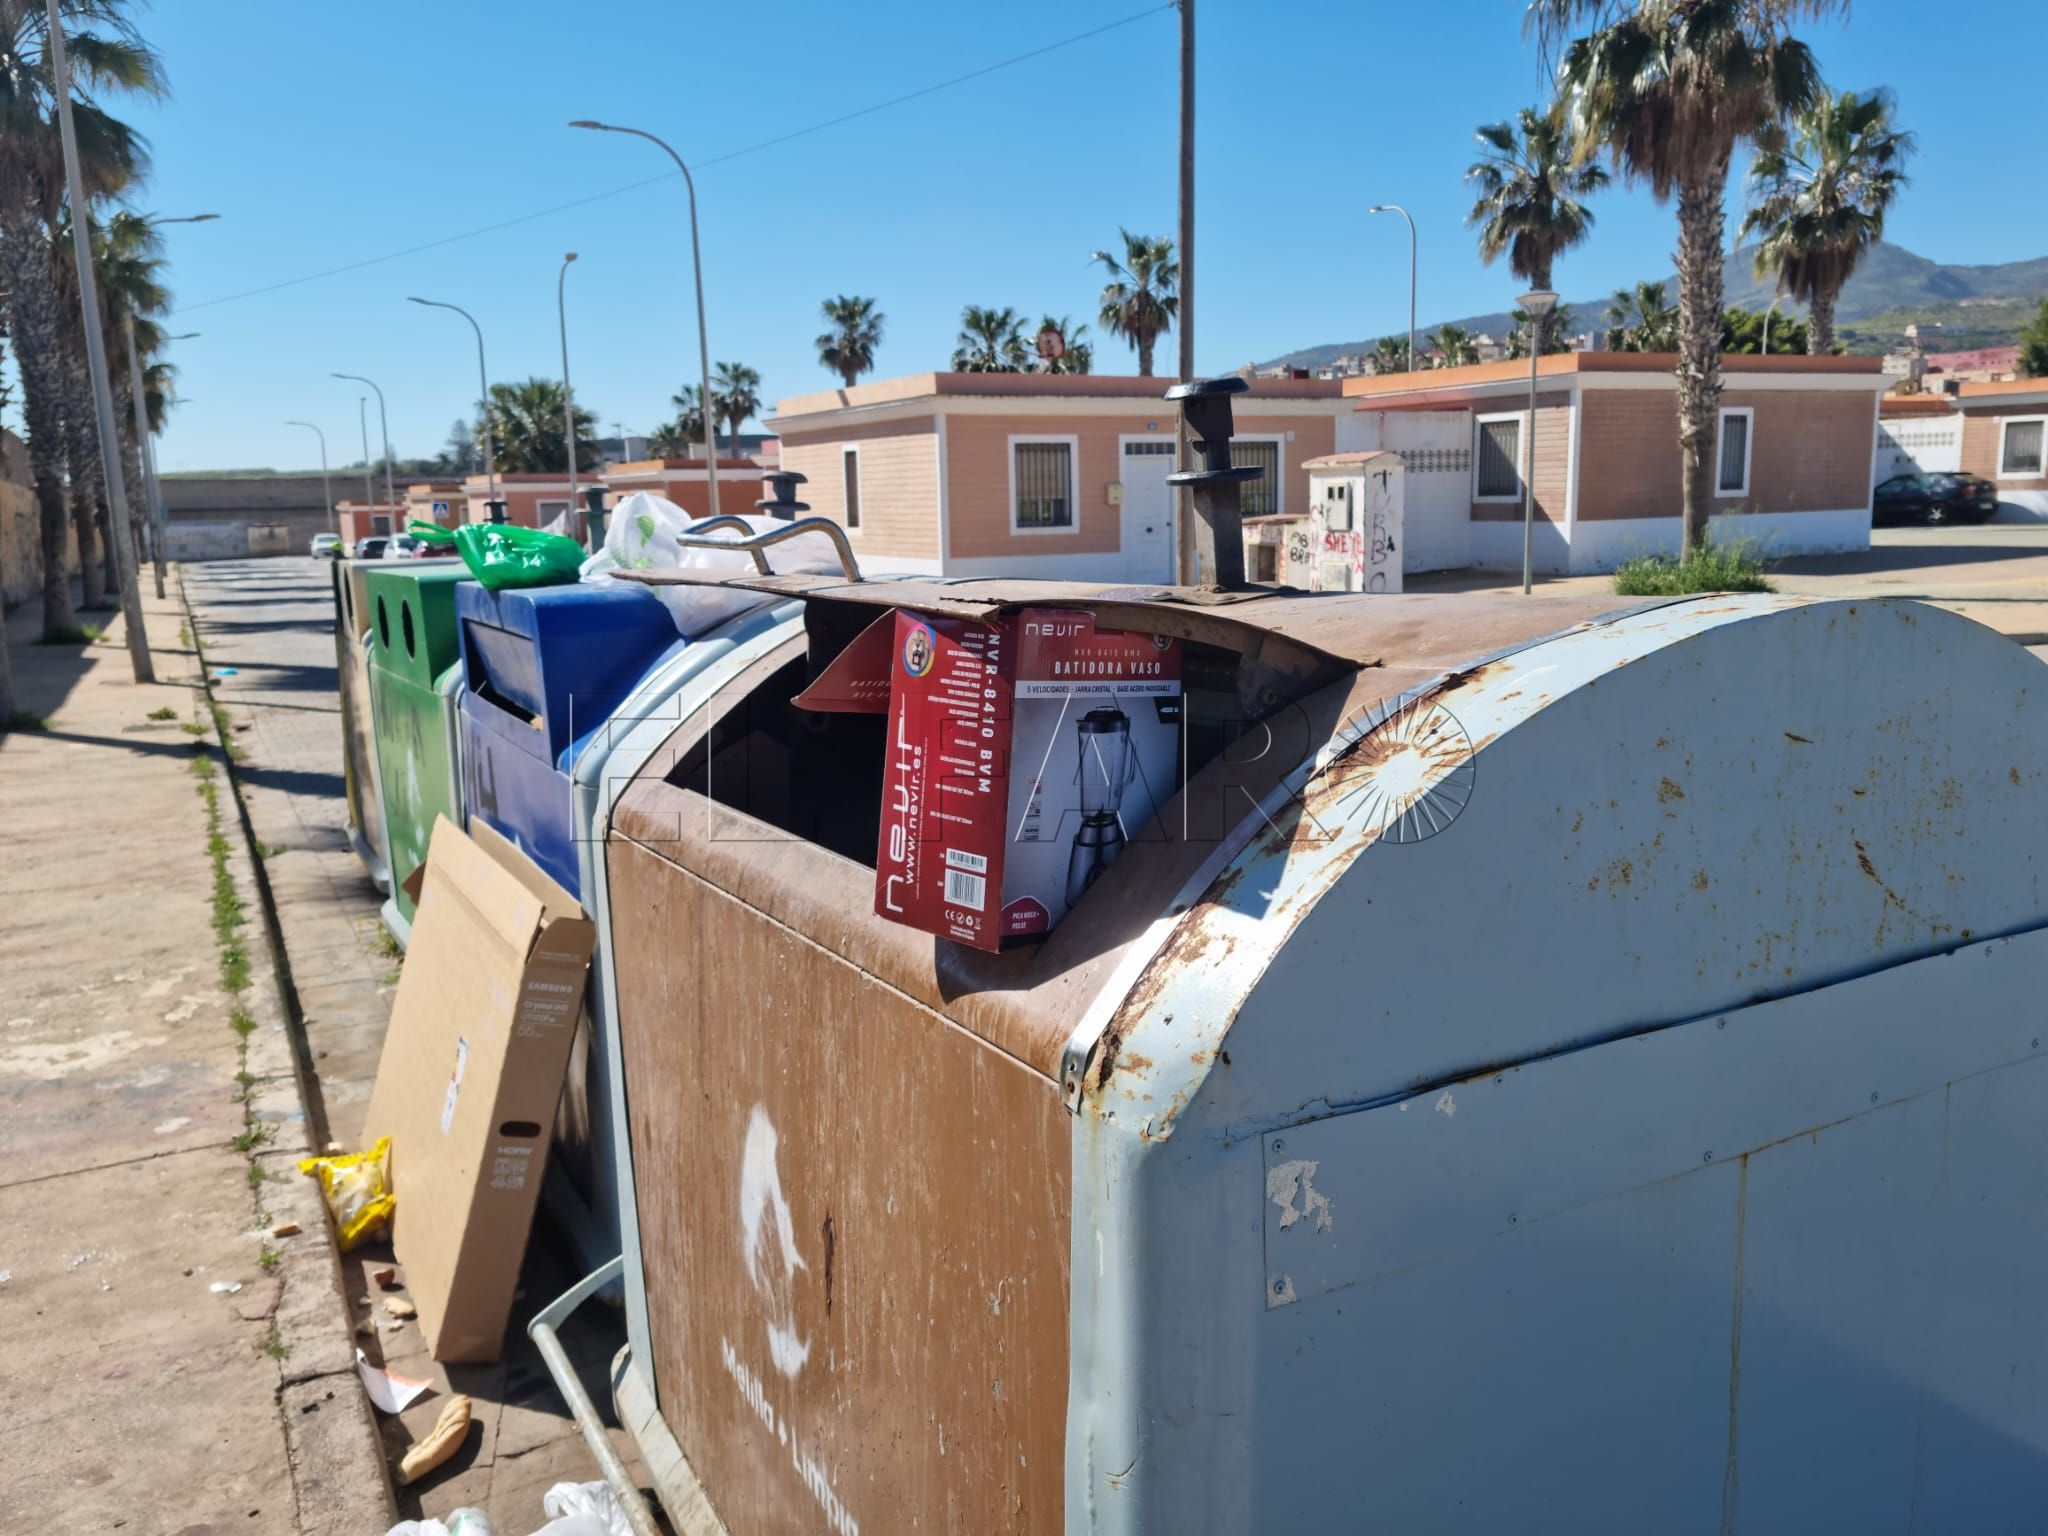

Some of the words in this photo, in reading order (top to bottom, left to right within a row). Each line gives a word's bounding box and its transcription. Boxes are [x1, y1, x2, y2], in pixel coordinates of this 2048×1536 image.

[981, 633, 1001, 738] NVR-8410
[1032, 685, 1069, 694] VELOCIDADES
[1054, 661, 1122, 675] BATIDORA
[1130, 661, 1161, 675] VASO
[978, 749, 993, 793] BVM
[906, 746, 922, 885] www.nevir.es
[527, 981, 573, 993] SAMSUNG
[722, 1335, 774, 1435] Melilla
